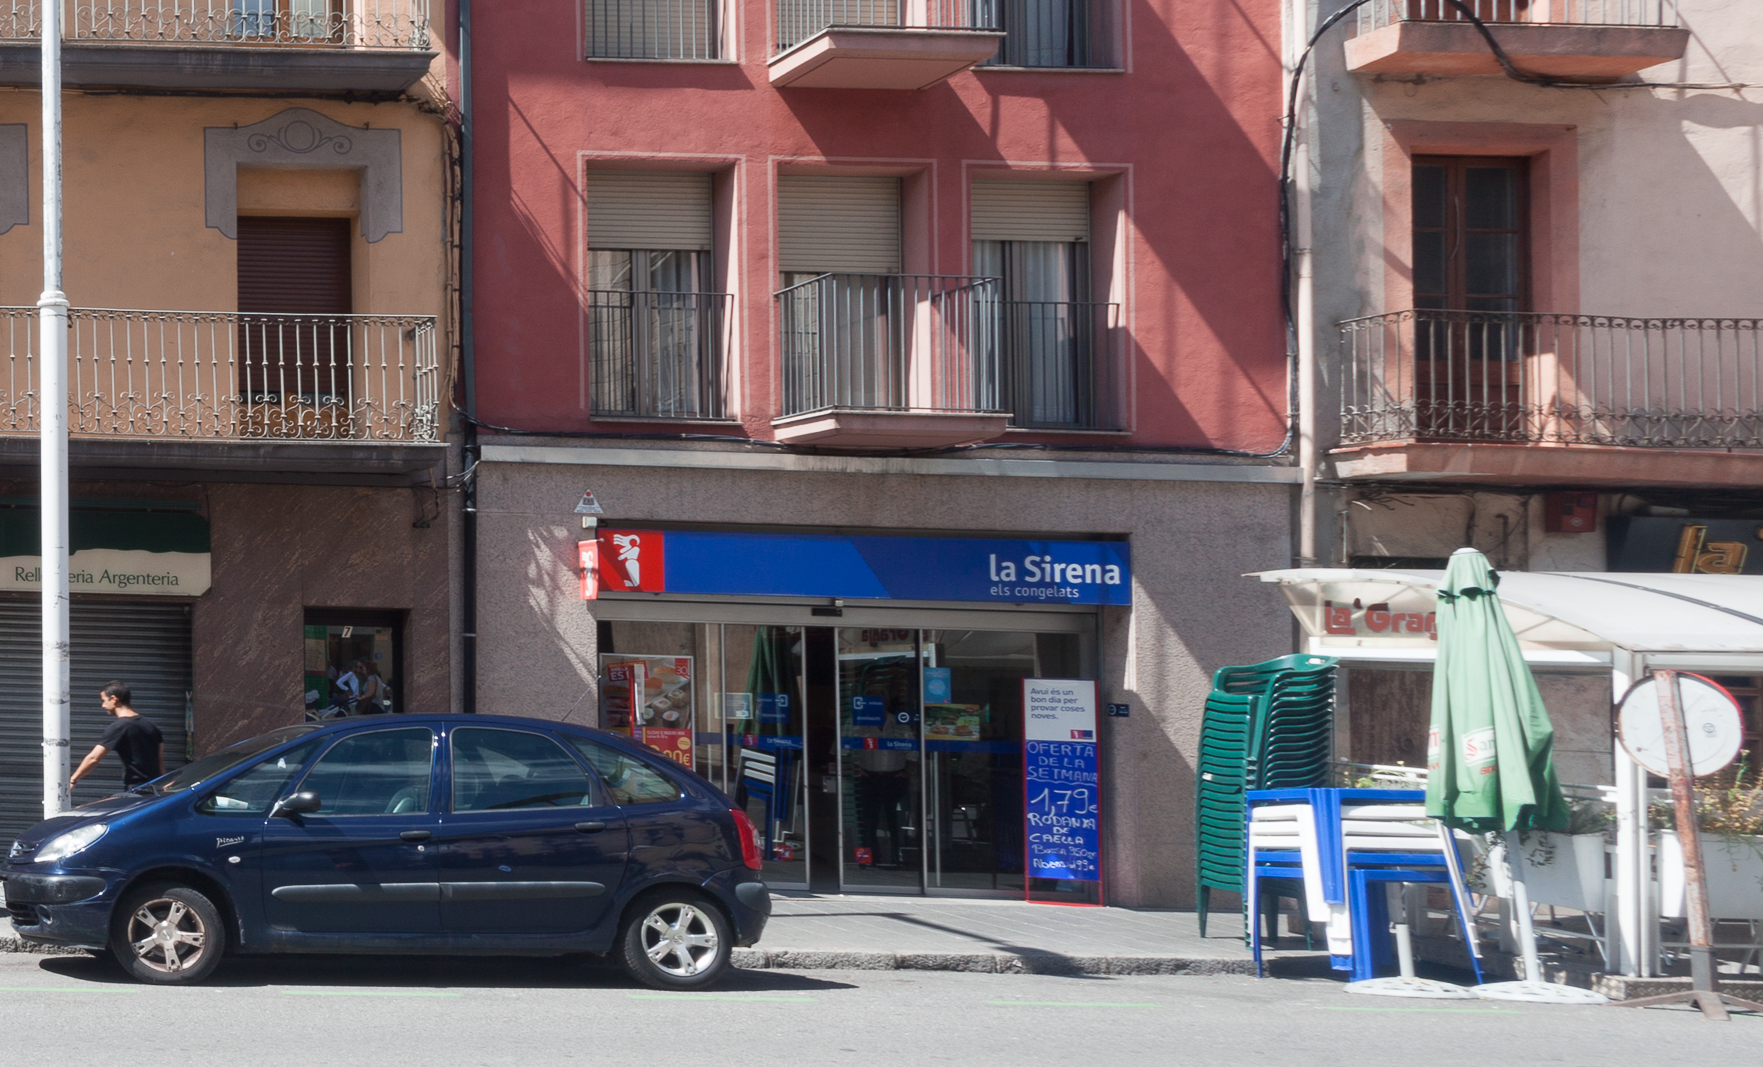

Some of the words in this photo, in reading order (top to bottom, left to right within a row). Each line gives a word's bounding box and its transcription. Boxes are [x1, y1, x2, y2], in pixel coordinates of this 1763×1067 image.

[989, 553, 1016, 582] la
[1024, 555, 1121, 585] Sirena
[15, 566, 94, 583] Relleria
[99, 568, 179, 588] Argenteria
[990, 584, 1010, 596] els
[1015, 585, 1080, 599] congelats
[1365, 602, 1437, 640] Gran
[343, 626, 351, 637] 7
[1027, 742, 1094, 757] OFERTA
[1038, 756, 1059, 766] DE
[1064, 758, 1085, 768] LA
[1028, 766, 1098, 782] SETMANA
